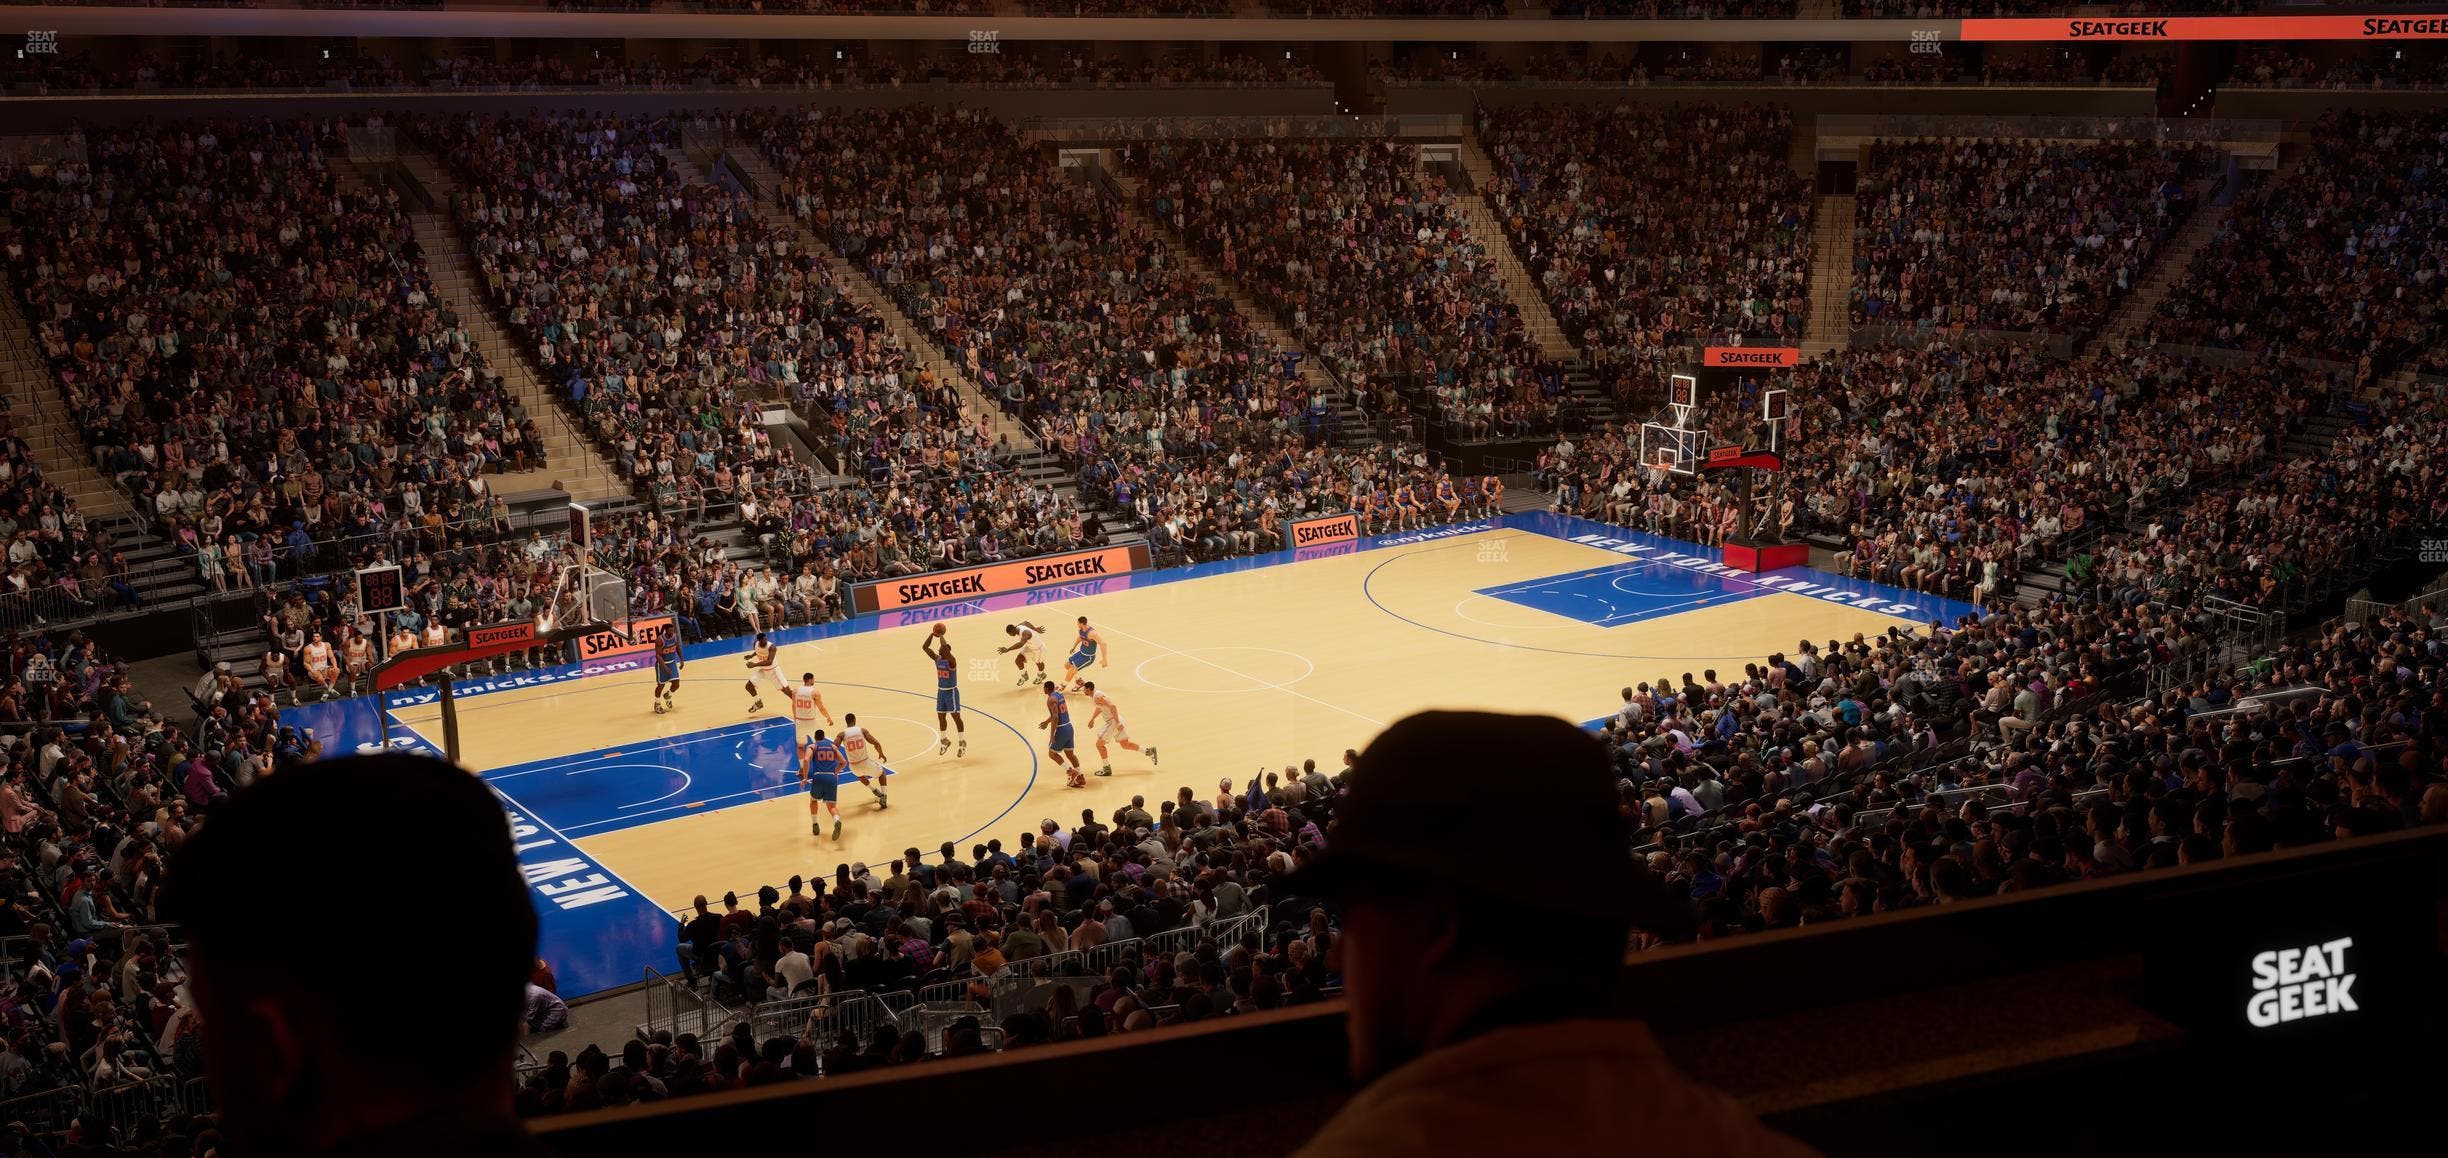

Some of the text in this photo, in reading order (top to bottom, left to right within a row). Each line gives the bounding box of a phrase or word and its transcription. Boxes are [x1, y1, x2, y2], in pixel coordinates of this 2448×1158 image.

[2069, 20, 2168, 37] SEATGEEK
[1720, 352, 1783, 364] SEATGEEK
[1297, 520, 1354, 543] SEATGEEK
[1377, 525, 1493, 545] @nyknicks
[1025, 554, 1107, 585] SEATGEEK
[1567, 534, 1918, 614] NEW YORK KNICKS
[899, 573, 987, 604] SEATGEEK
[475, 626, 529, 644] SEATGEEK
[796, 698, 812, 709] 00
[817, 750, 834, 762] 00
[847, 739, 864, 752] 00
[517, 856, 630, 910] NEW
[2251, 936, 2353, 991] SEAT
[2246, 973, 2360, 1028] GEEK
